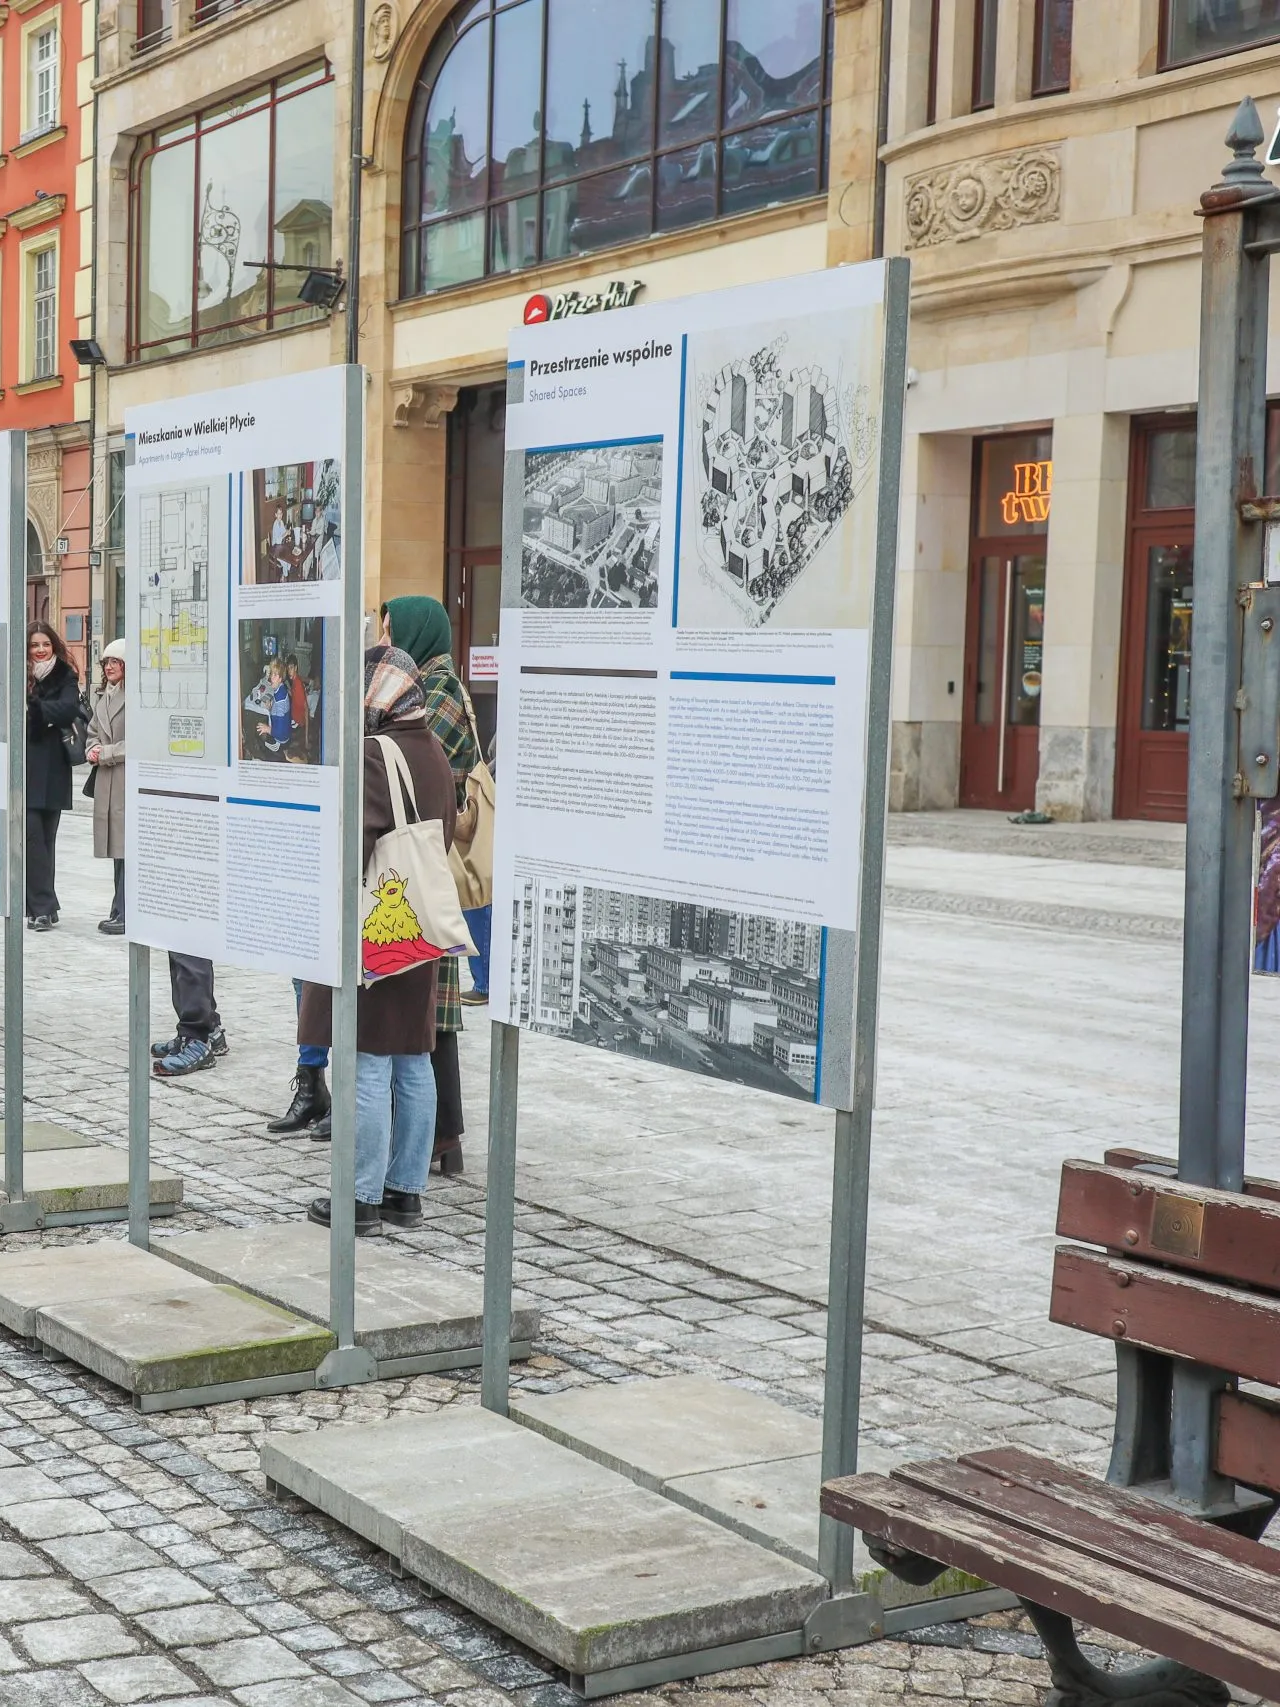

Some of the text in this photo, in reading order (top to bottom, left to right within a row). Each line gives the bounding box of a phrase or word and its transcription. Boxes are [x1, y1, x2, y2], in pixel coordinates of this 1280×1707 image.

[550, 280, 645, 320] Pizza Hut
[530, 339, 673, 377] Przestrzenie wspólne
[529, 385, 587, 402] Shared Spaces
[138, 412, 256, 446] Mieszkania w Wielkiej Płycie
[138, 453, 165, 467] Apartments
[200, 444, 222, 456] Housing
[59, 541, 66, 550] 51
